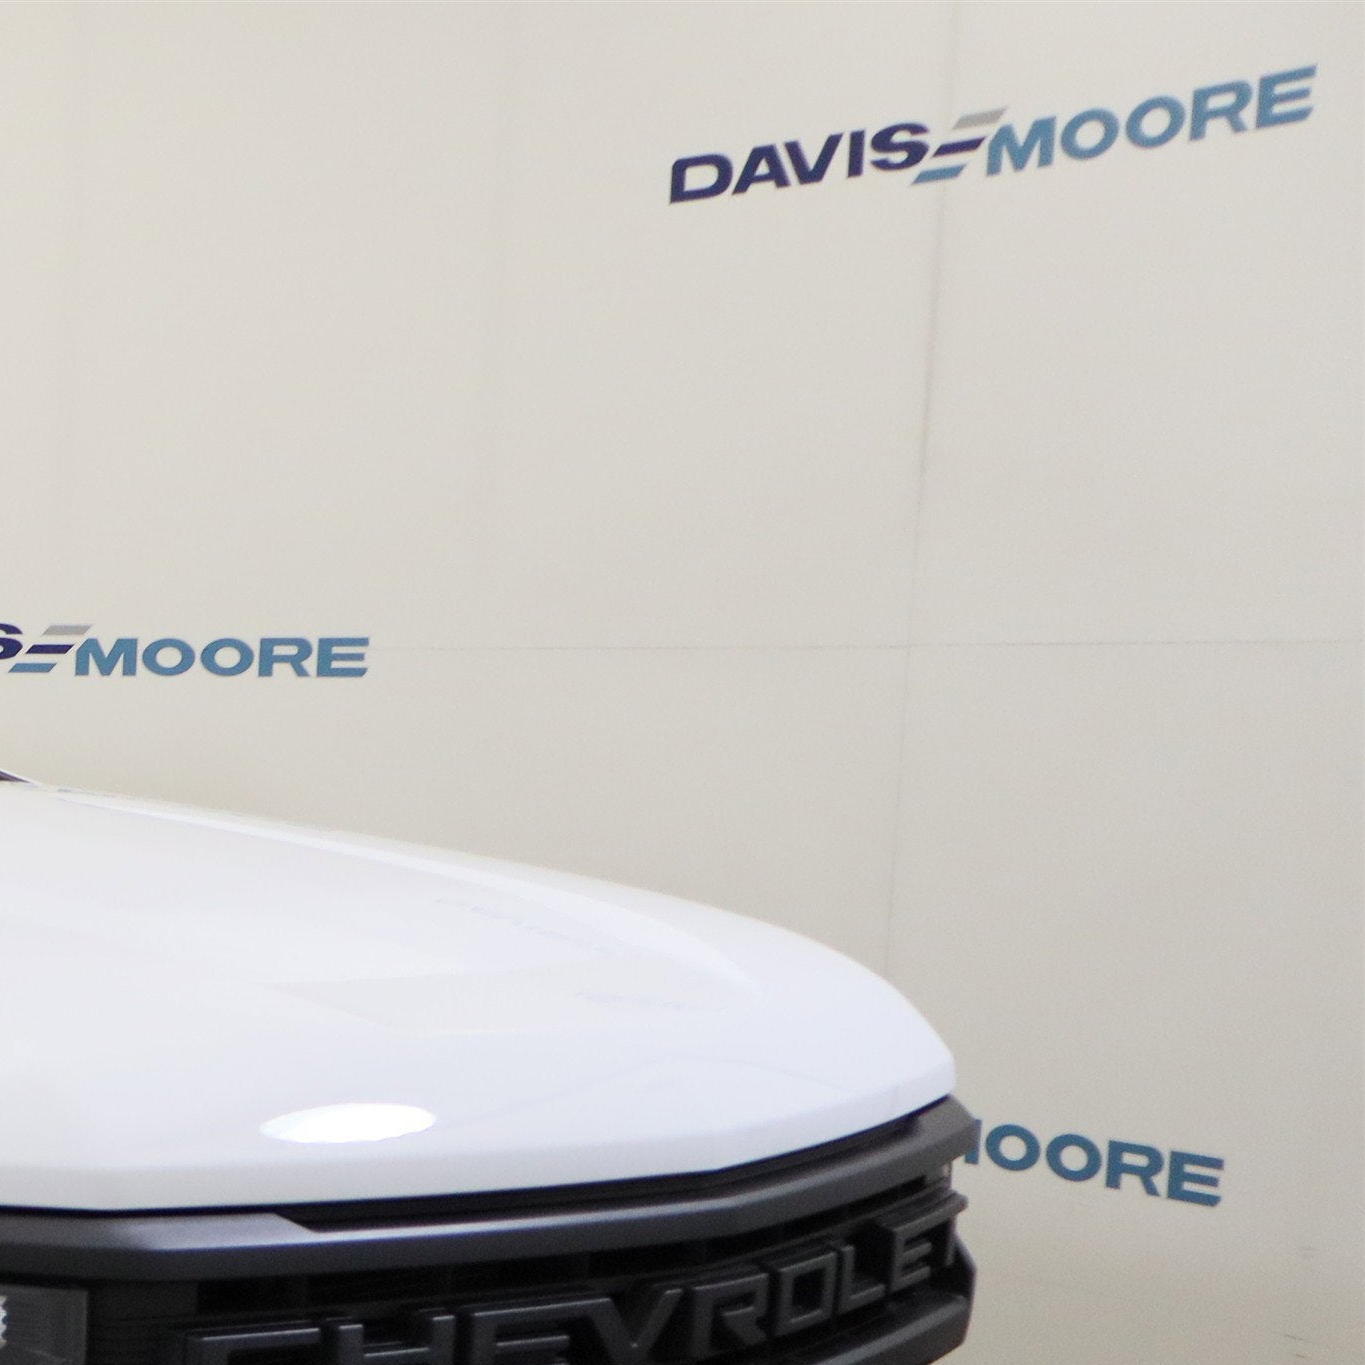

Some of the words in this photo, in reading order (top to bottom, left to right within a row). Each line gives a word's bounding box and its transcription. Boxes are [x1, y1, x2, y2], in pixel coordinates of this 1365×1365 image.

[669, 122, 930, 204] DAVIS
[985, 63, 1317, 176] MOORE
[74, 637, 370, 678] MOORE
